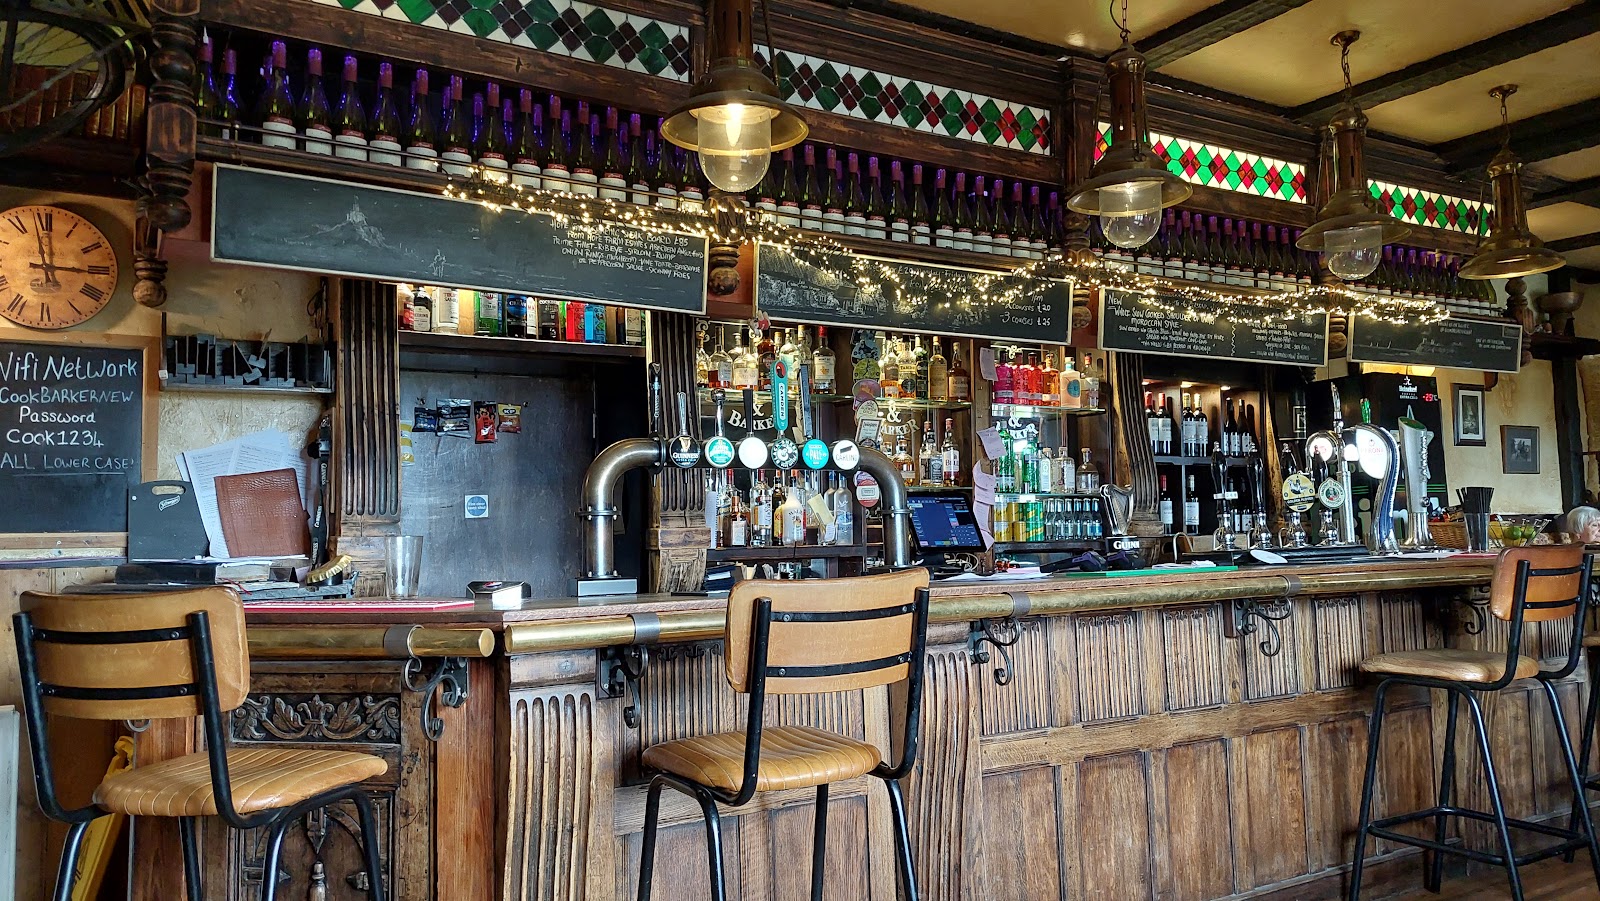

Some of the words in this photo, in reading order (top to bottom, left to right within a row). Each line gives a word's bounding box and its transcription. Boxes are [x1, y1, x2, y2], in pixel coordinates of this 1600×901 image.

[553, 235, 573, 247] PRIME
[647, 235, 671, 244] BOARD
[562, 248, 584, 257] ONION
[673, 271, 691, 280] FRIES
[1131, 318, 1162, 328] MOROCCAN
[778, 384, 786, 419] CAMDEN
[19, 405, 97, 424] Password
[6, 428, 105, 448] Cook1234
[1, 452, 36, 470] ALL
[43, 454, 91, 469] LOWER
